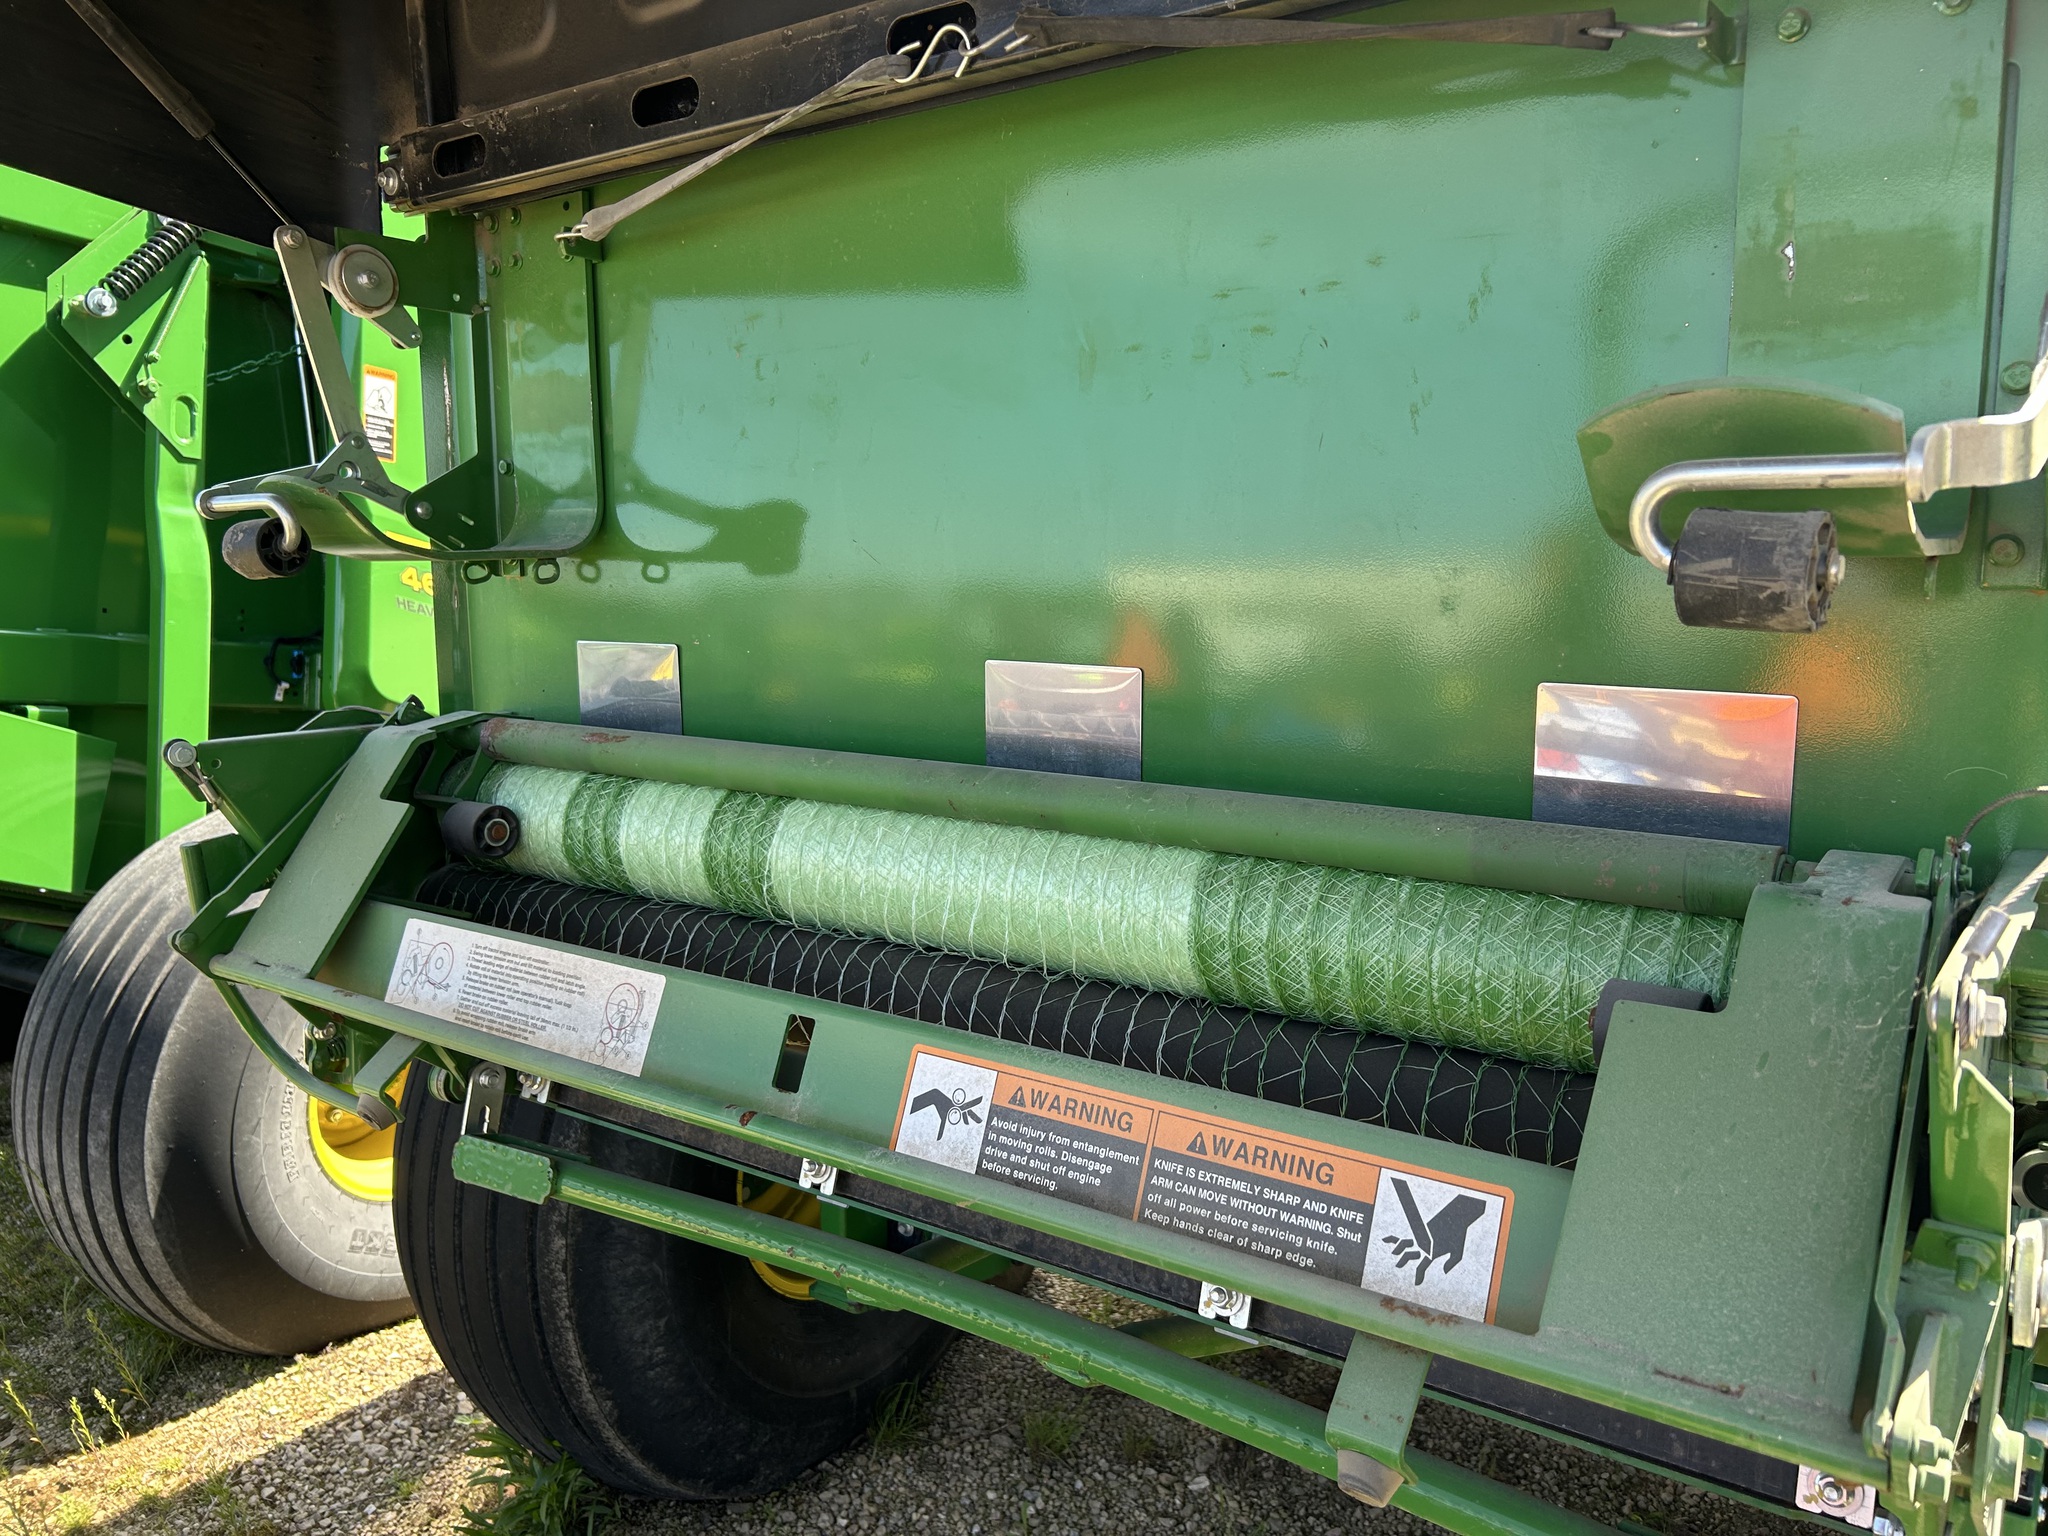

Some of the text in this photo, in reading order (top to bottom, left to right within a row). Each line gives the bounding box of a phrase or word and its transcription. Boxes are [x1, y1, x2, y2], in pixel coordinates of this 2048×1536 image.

[400, 565, 434, 596] 46
[396, 596, 435, 617] HEAV
[1029, 1088, 1133, 1131] WARNING
[987, 1131, 1112, 1175] in moving rolls. Disengage
[991, 1116, 1140, 1167] Avoid injury from entanglement
[1211, 1134, 1335, 1184] WARNING
[981, 1159, 1059, 1191] before servicing.
[984, 1145, 1101, 1188] drive and shut off engine
[1150, 1175, 1361, 1242] ARM CAN MOVE WITHOUT WARNING. Shut
[1153, 1159, 1364, 1223] KNIFE IS EXTREMELY SHARP AND KNIFE
[1143, 1208, 1316, 1269] Keep hands clear of sharp edge.
[1147, 1192, 1338, 1254] off all power before servicing knife.
